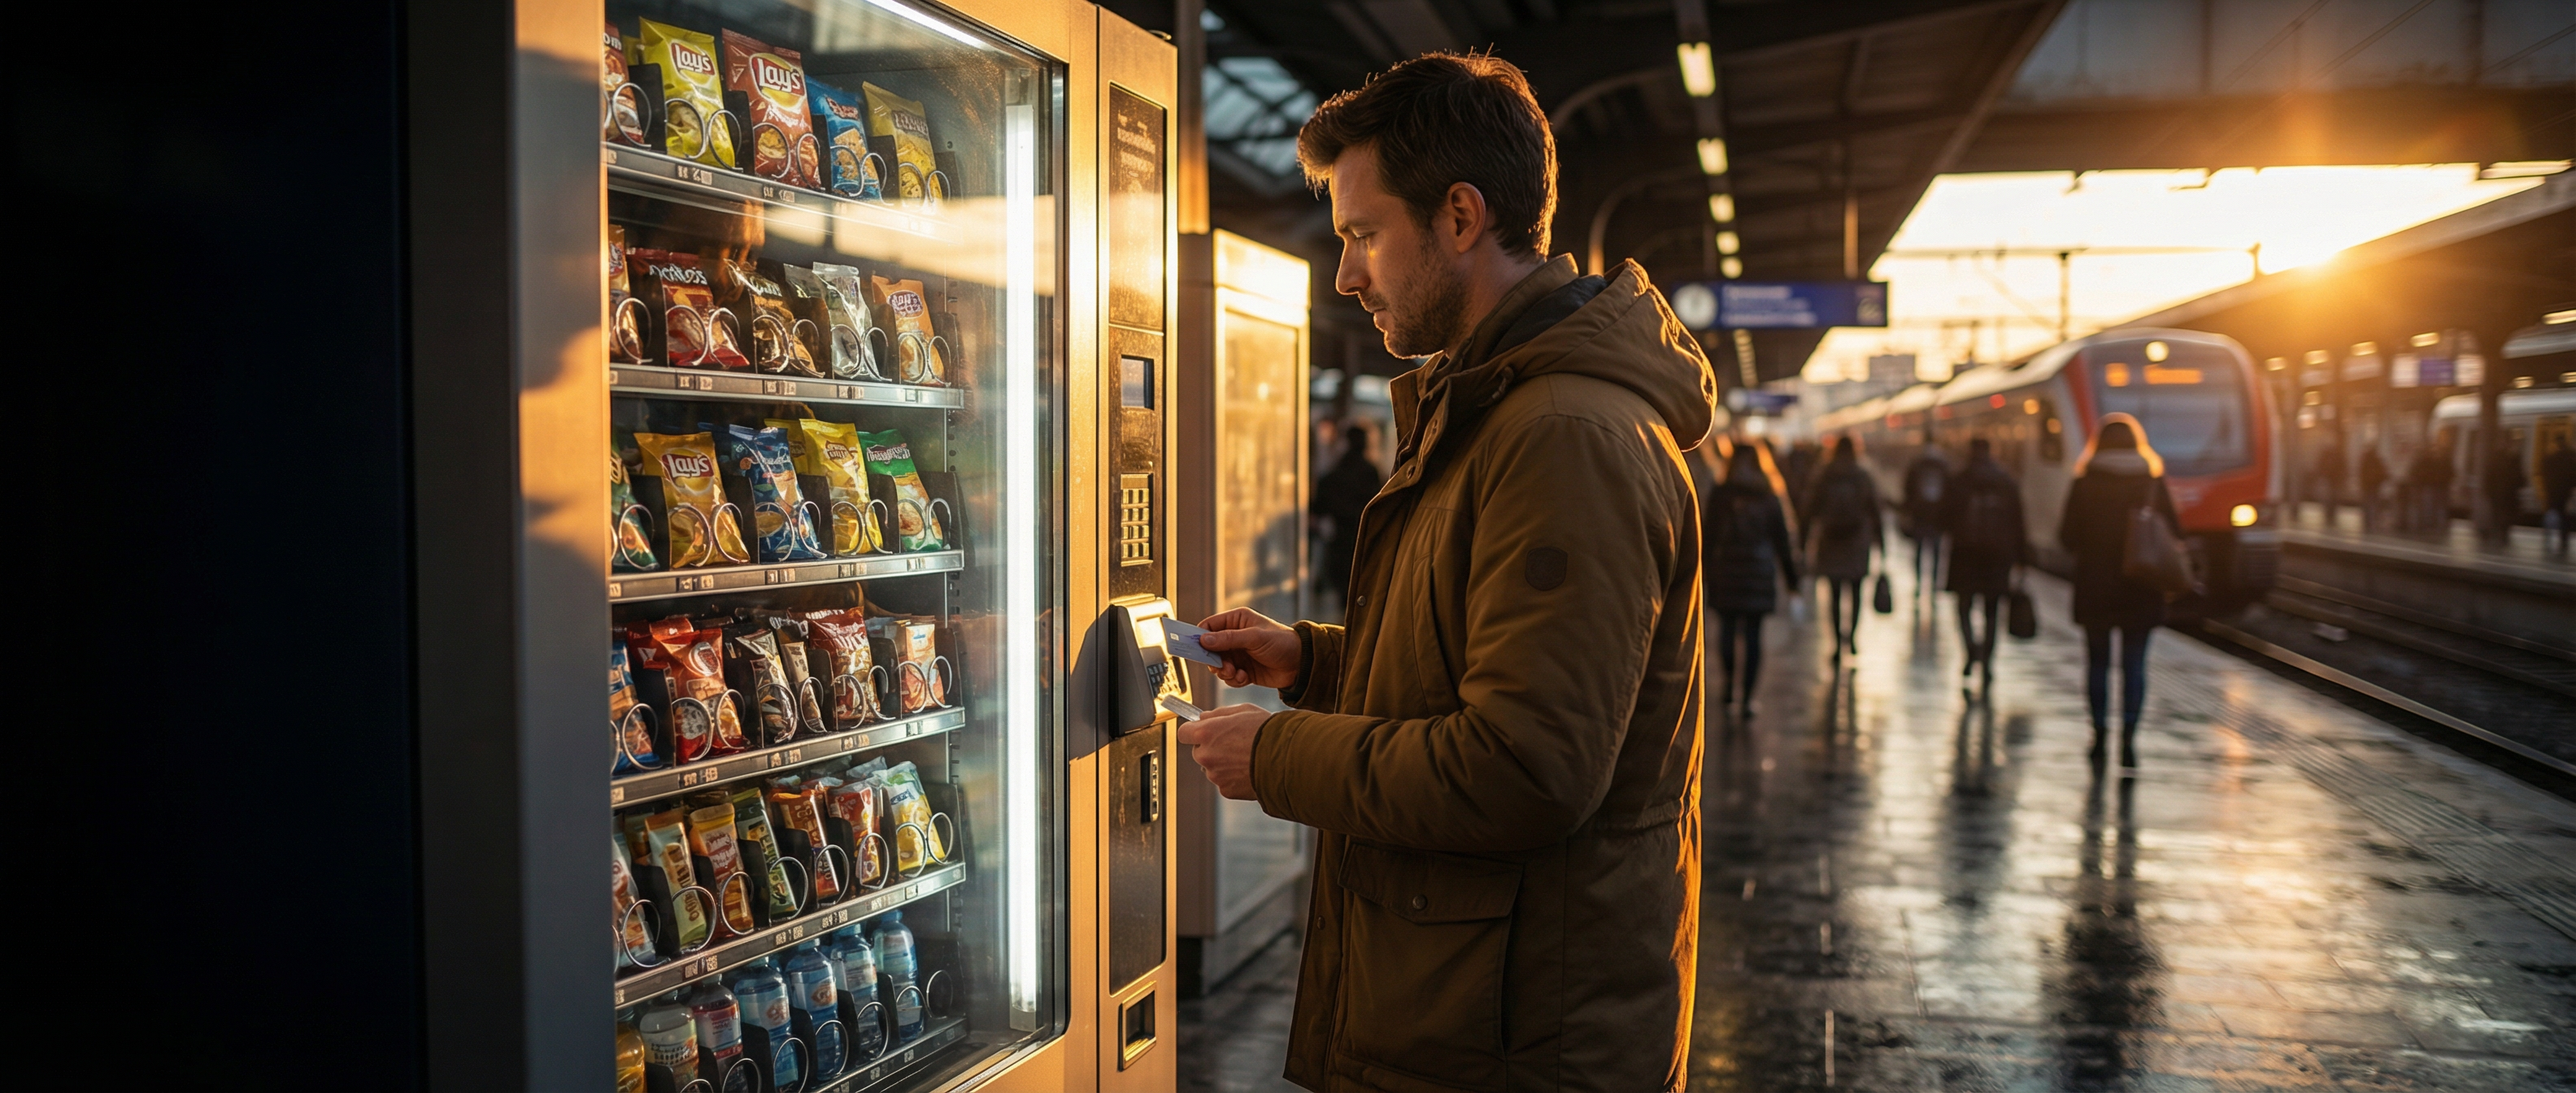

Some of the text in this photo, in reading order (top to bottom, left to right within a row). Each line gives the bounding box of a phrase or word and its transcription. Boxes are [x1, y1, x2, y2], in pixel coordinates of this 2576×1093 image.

[674, 44, 712, 73] Lay's
[756, 58, 801, 93] Lay's
[666, 454, 710, 478] Lay's
